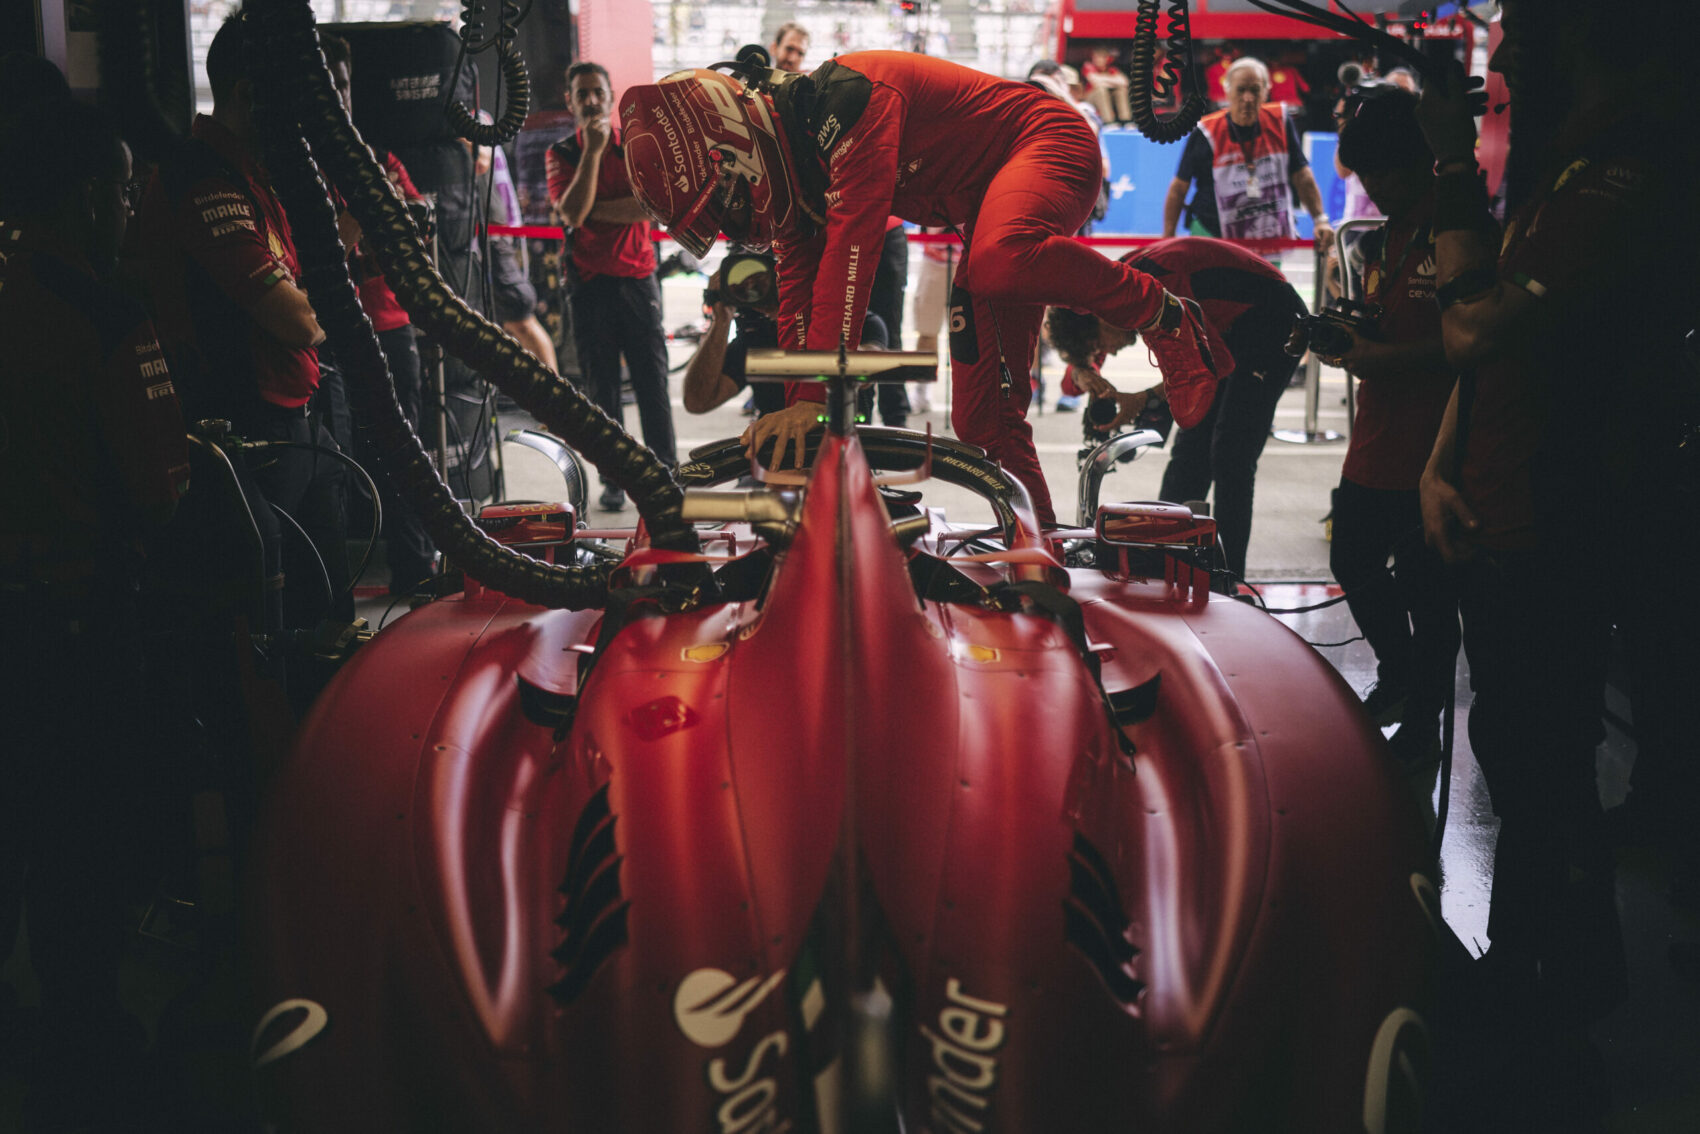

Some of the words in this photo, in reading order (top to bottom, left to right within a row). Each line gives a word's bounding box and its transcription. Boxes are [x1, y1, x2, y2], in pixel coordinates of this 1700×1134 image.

[669, 91, 695, 134] Bitdefender
[652, 105, 687, 173] Santander
[817, 114, 838, 147] aws
[201, 202, 251, 222] MAHLE
[847, 244, 860, 282] MILLE
[796, 311, 805, 345] MILLE
[842, 285, 855, 341] RICHARD
[680, 462, 711, 474] aws
[942, 456, 985, 478] RICHARD
[981, 474, 1005, 490] MILLE
